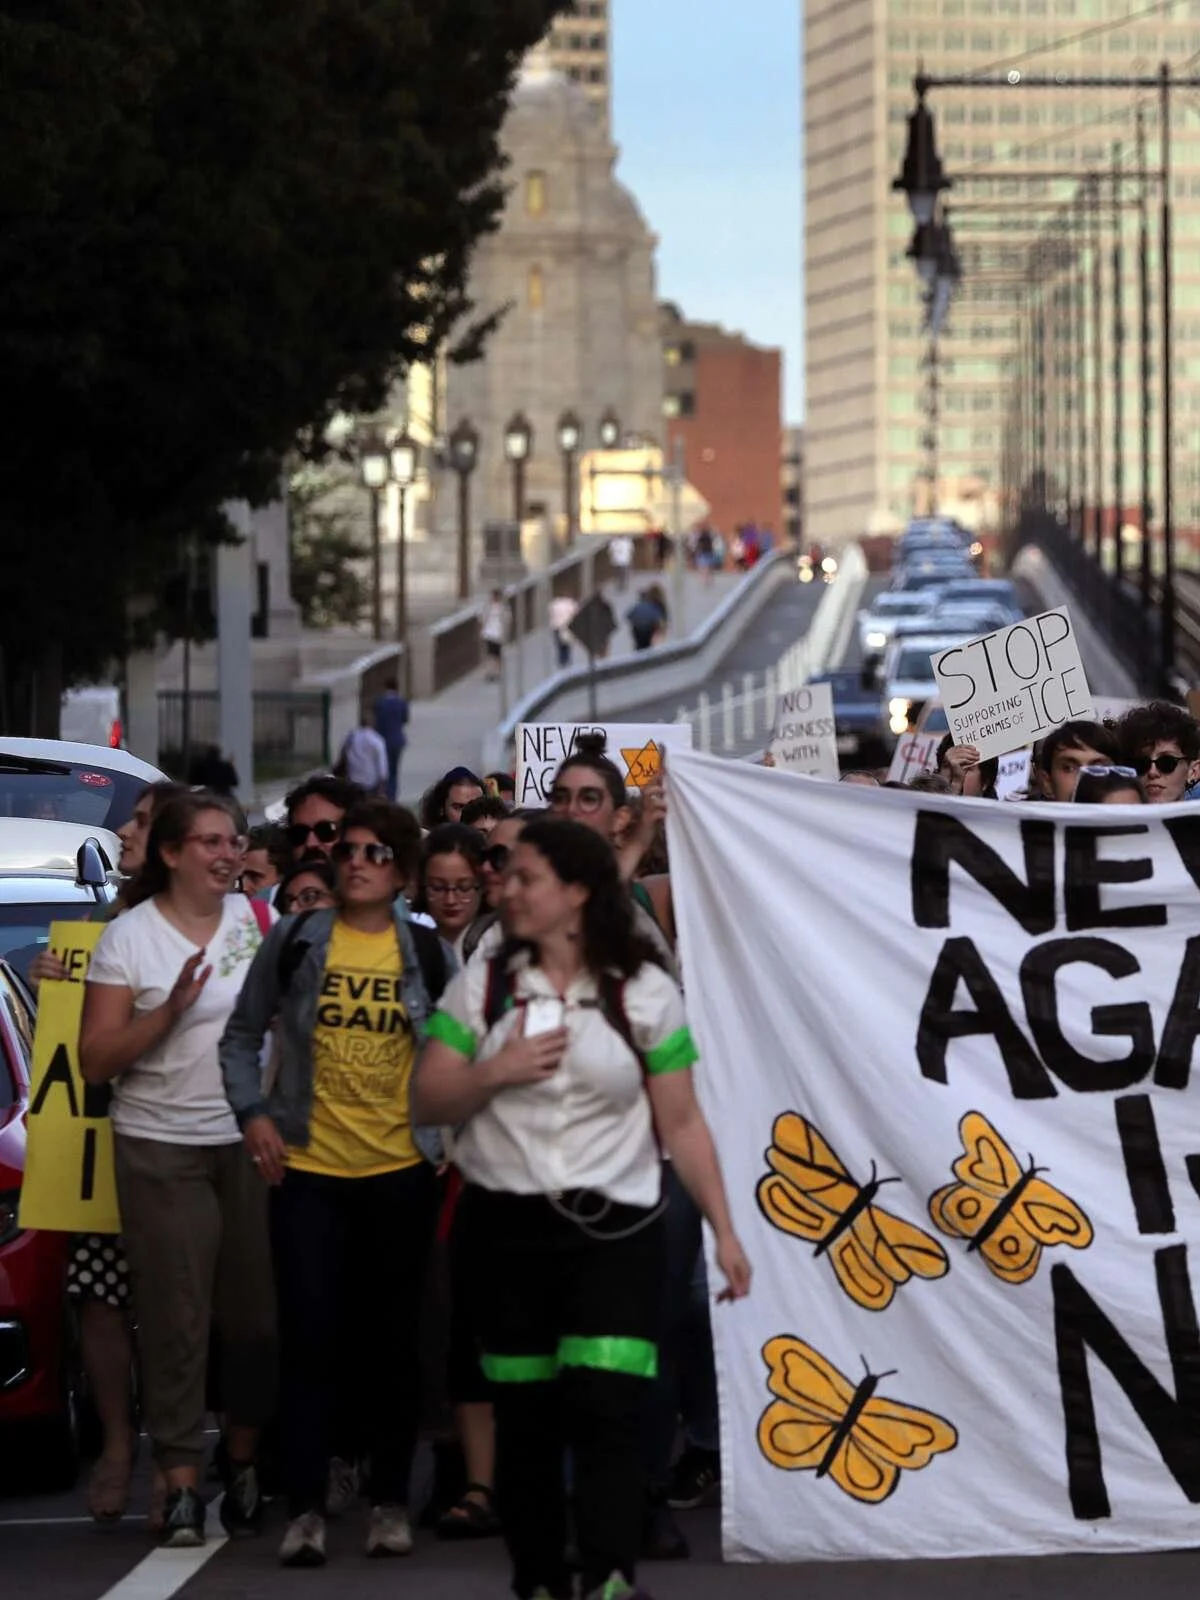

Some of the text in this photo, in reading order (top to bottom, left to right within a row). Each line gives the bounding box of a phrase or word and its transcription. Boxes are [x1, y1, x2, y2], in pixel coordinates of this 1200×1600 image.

[938, 612, 1070, 709] STOP
[782, 689, 813, 714] NO
[953, 694, 1022, 732] SUPPORTING
[778, 718, 834, 741] USINESS
[957, 711, 1025, 745] THE CRIMES OF
[782, 744, 820, 764] WITH
[317, 1002, 412, 1034] GAIN
